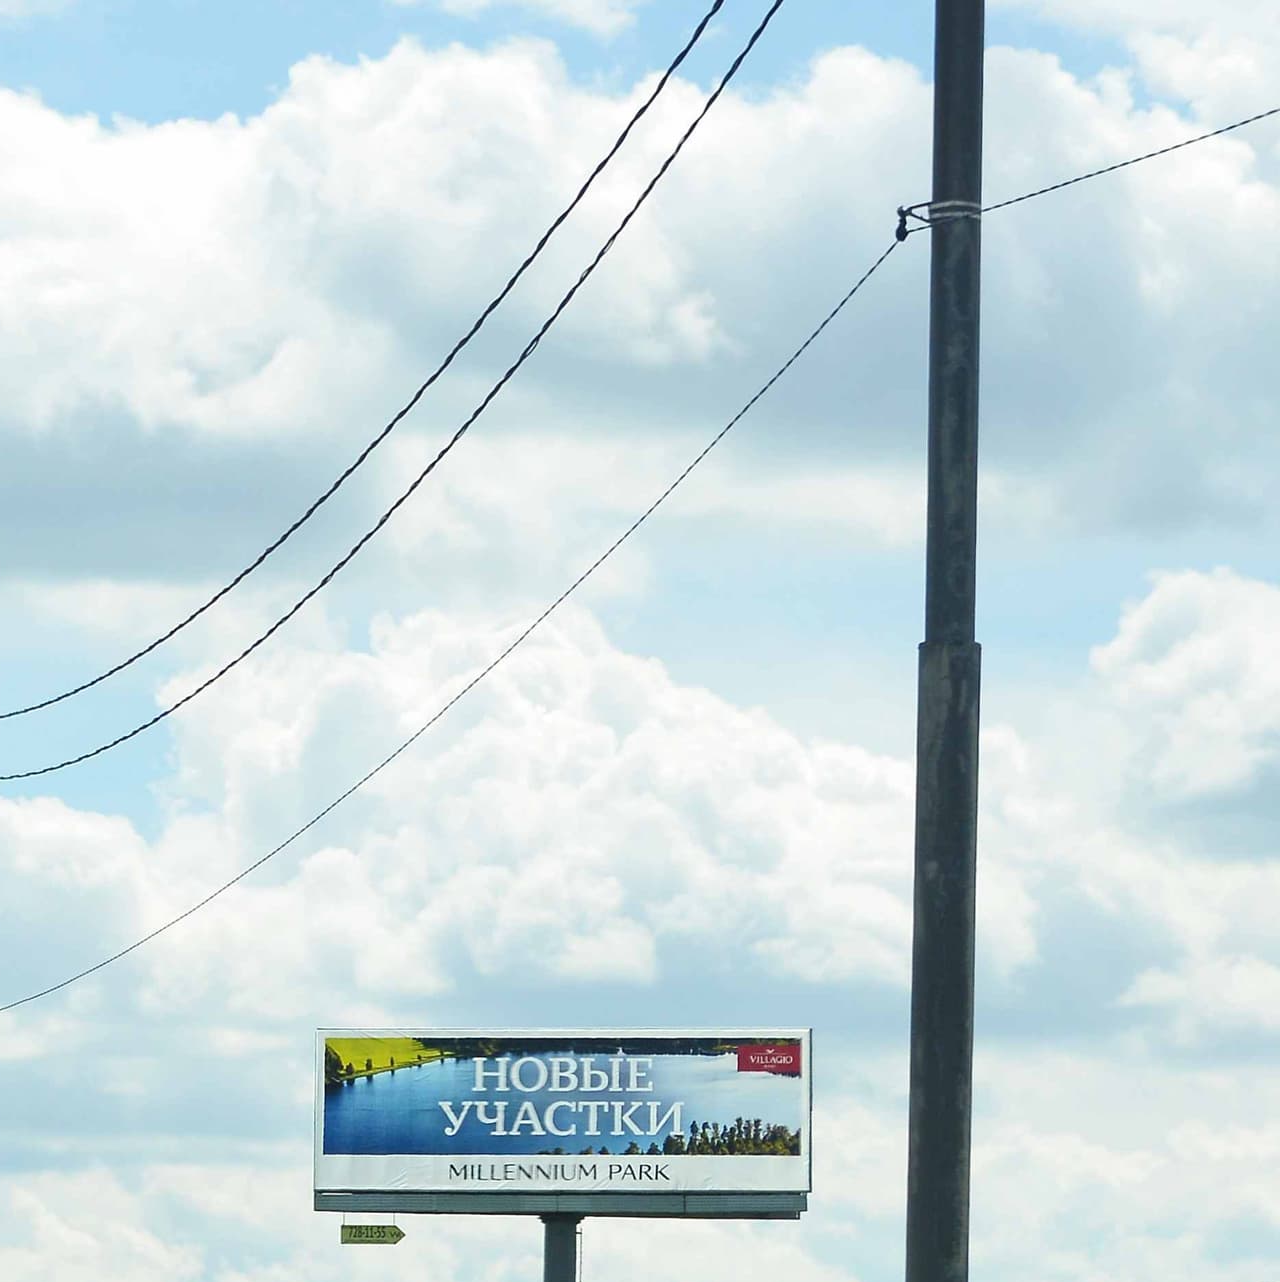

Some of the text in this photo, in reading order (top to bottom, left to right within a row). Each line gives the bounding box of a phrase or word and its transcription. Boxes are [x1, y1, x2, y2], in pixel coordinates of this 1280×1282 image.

[750, 1055, 793, 1065] VILLAGIO
[472, 1056, 654, 1093] НОВЫЕ
[438, 1101, 686, 1137] УЧАСТКИ
[448, 1164, 671, 1181] MILLENNIUM PARK
